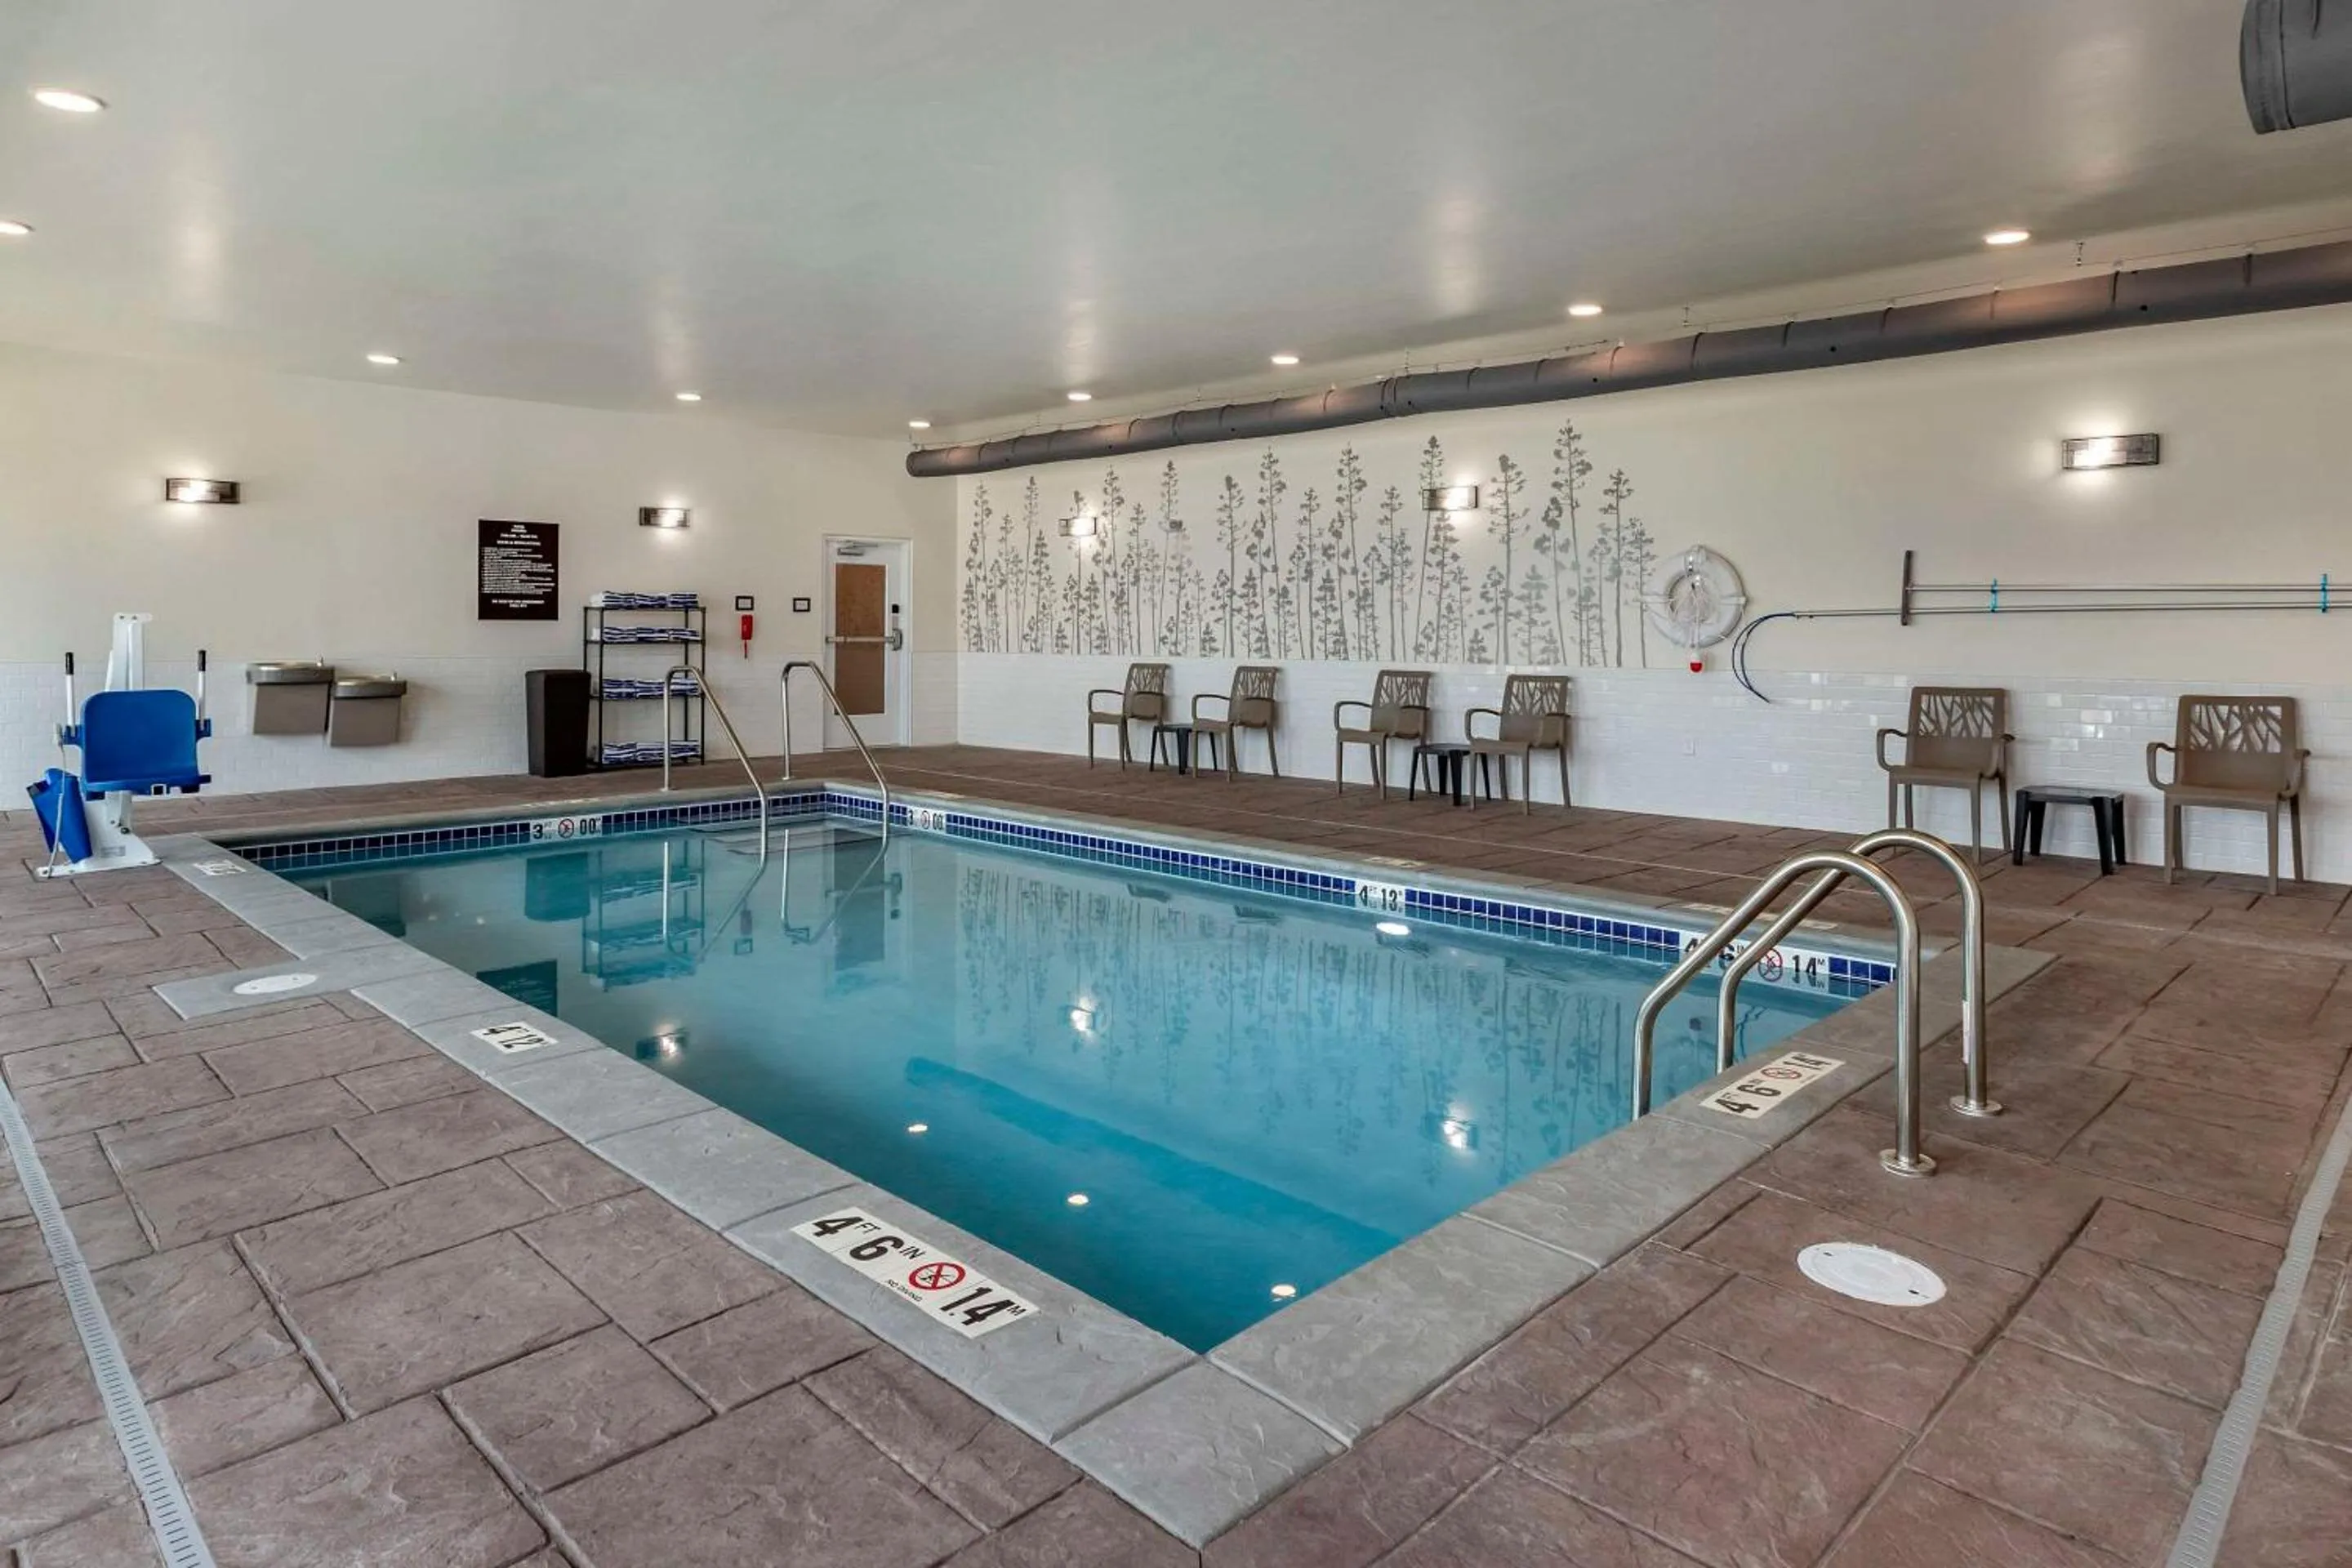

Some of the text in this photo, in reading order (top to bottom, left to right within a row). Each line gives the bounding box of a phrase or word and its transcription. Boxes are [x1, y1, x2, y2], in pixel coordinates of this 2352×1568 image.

[1736, 1084, 1782, 1097] 6
[1715, 1097, 1760, 1114] 4
[811, 1216, 865, 1238] 4
[854, 1222, 882, 1235] FT
[849, 1235, 905, 1262] 6
[898, 1245, 928, 1260] IN
[1006, 1304, 1028, 1317] M
